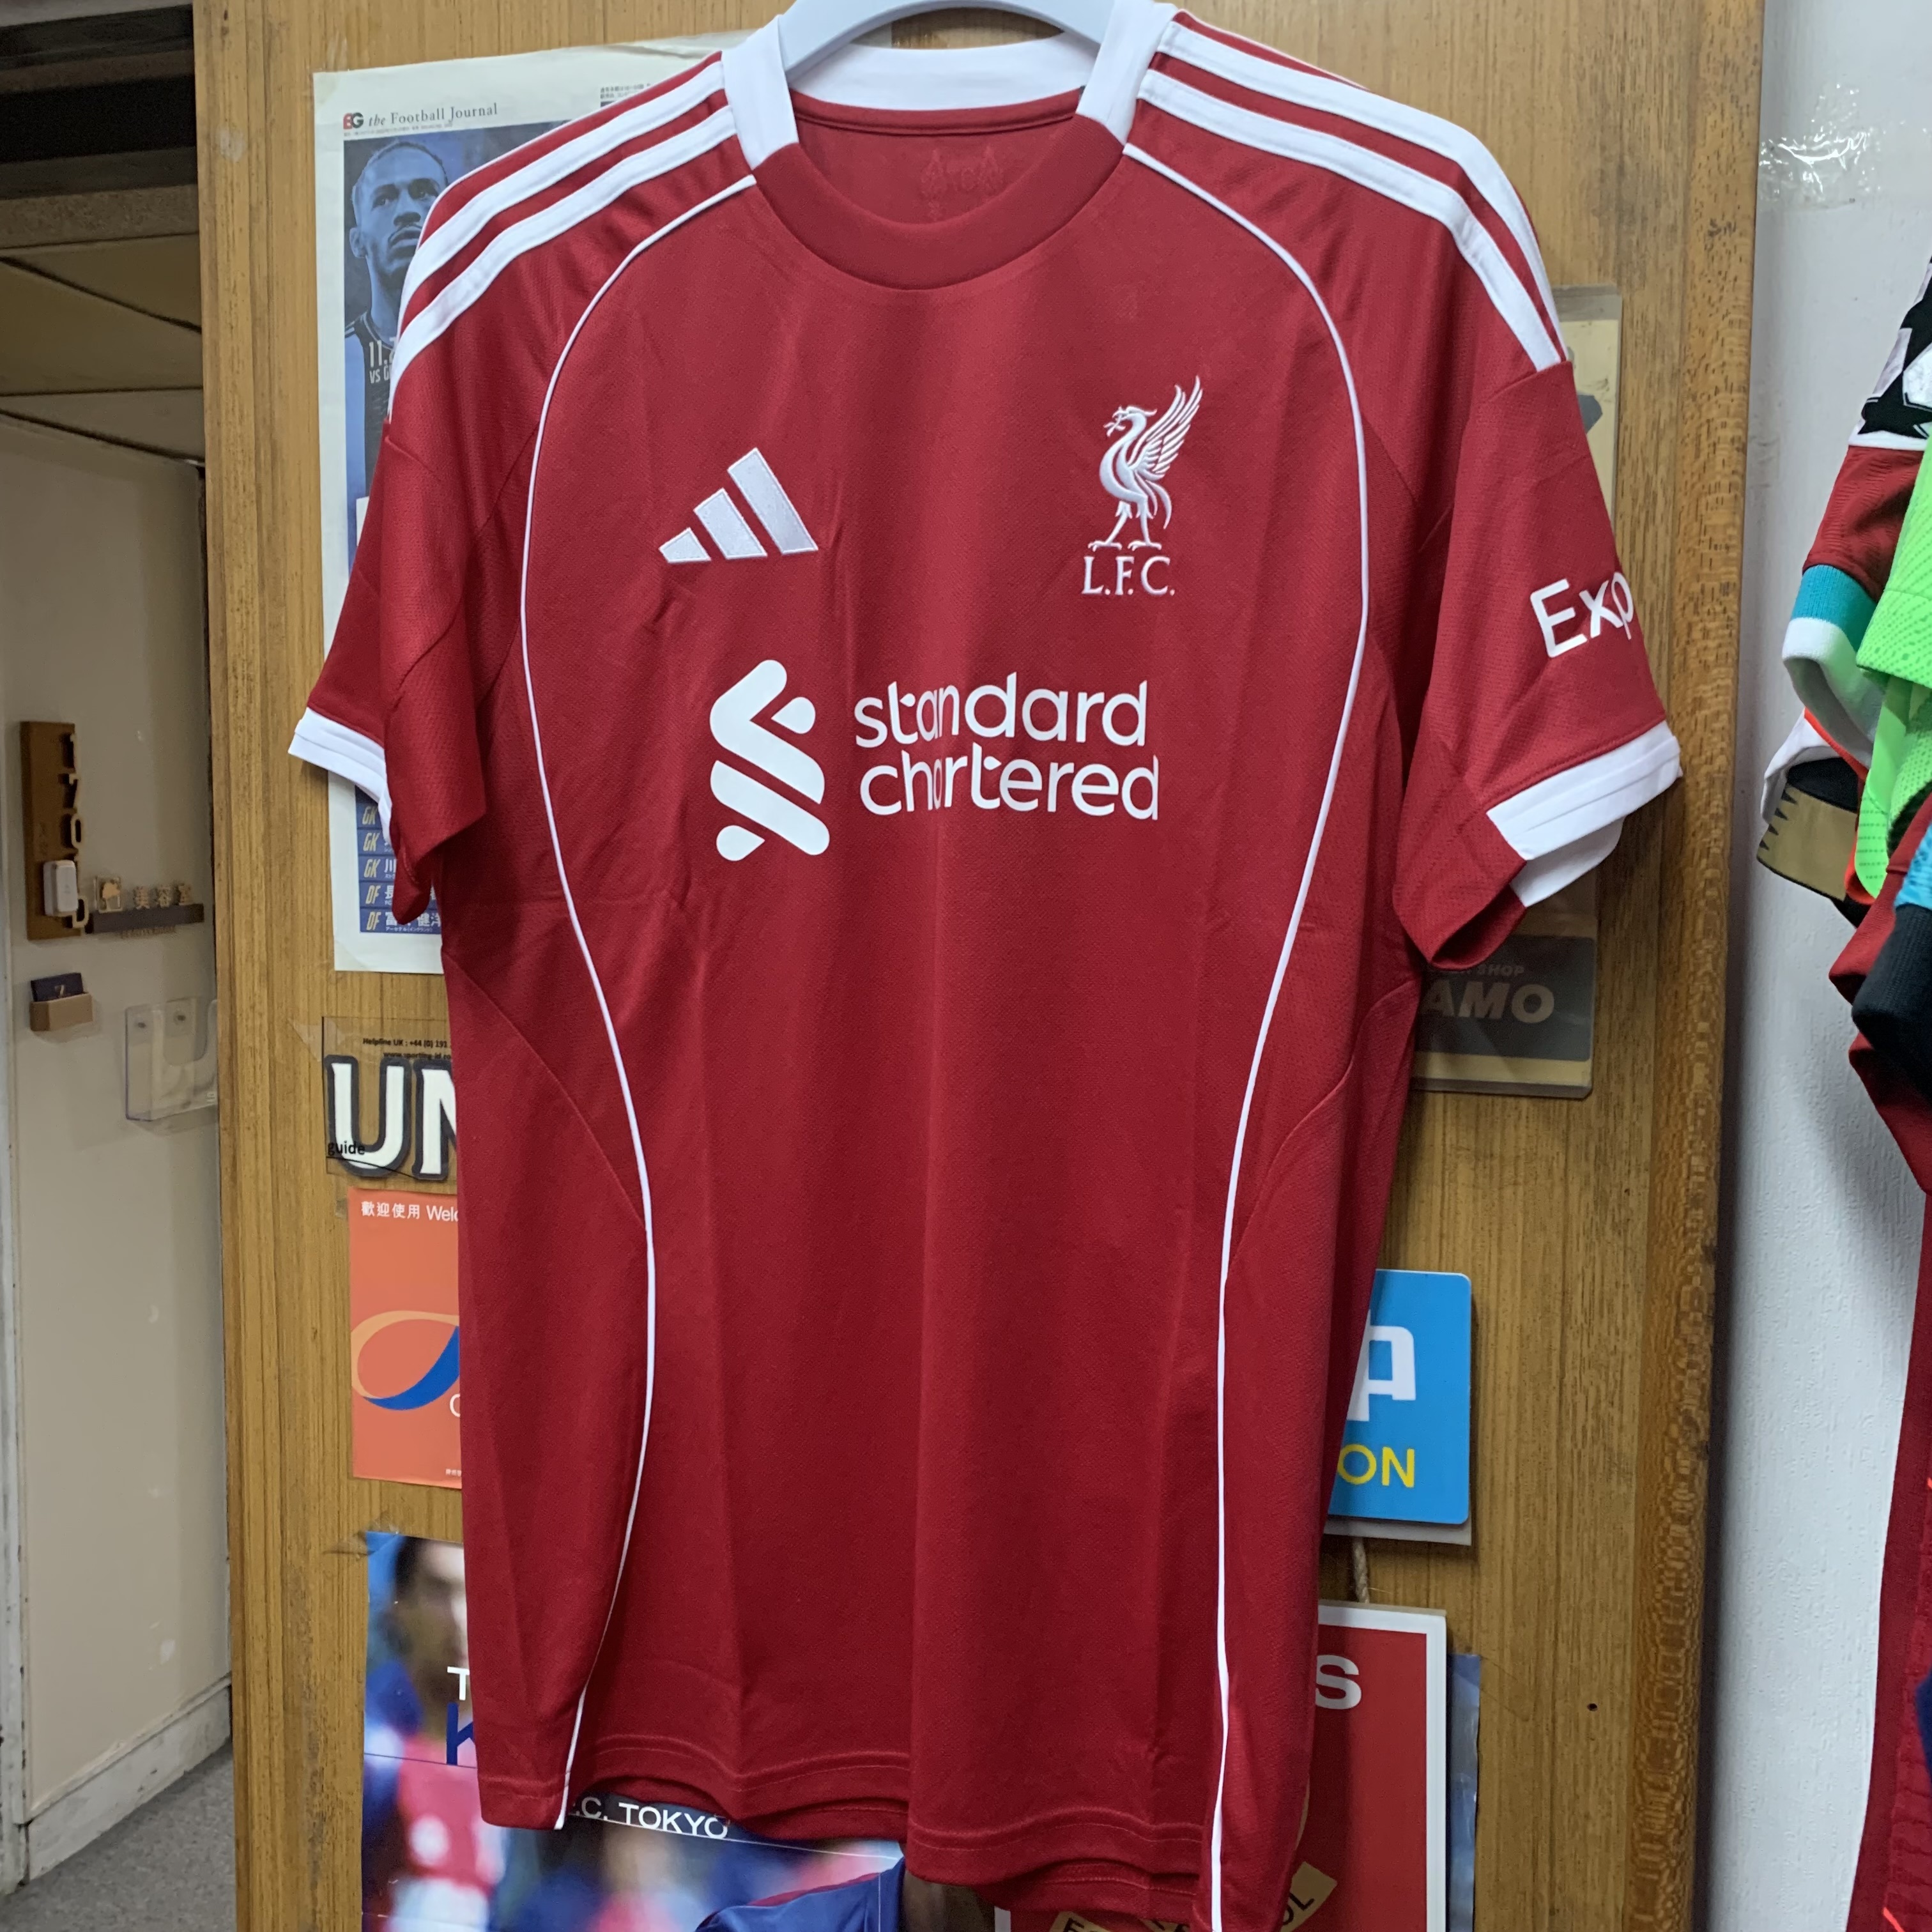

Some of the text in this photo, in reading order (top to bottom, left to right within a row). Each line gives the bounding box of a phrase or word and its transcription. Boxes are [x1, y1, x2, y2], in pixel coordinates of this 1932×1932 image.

[368, 114, 386, 126] the
[390, 107, 445, 125] Football
[449, 102, 498, 121] Journal
[1082, 556, 1175, 595] L.F.C.
[855, 671, 1147, 747] standard
[859, 742, 1158, 820] chartered
[363, 832, 380, 852] GK
[364, 859, 381, 878] GK
[365, 885, 381, 904] DF
[366, 912, 381, 931] DF
[327, 1140, 365, 1155] guide
[618, 1802, 729, 1839] TOKYO
